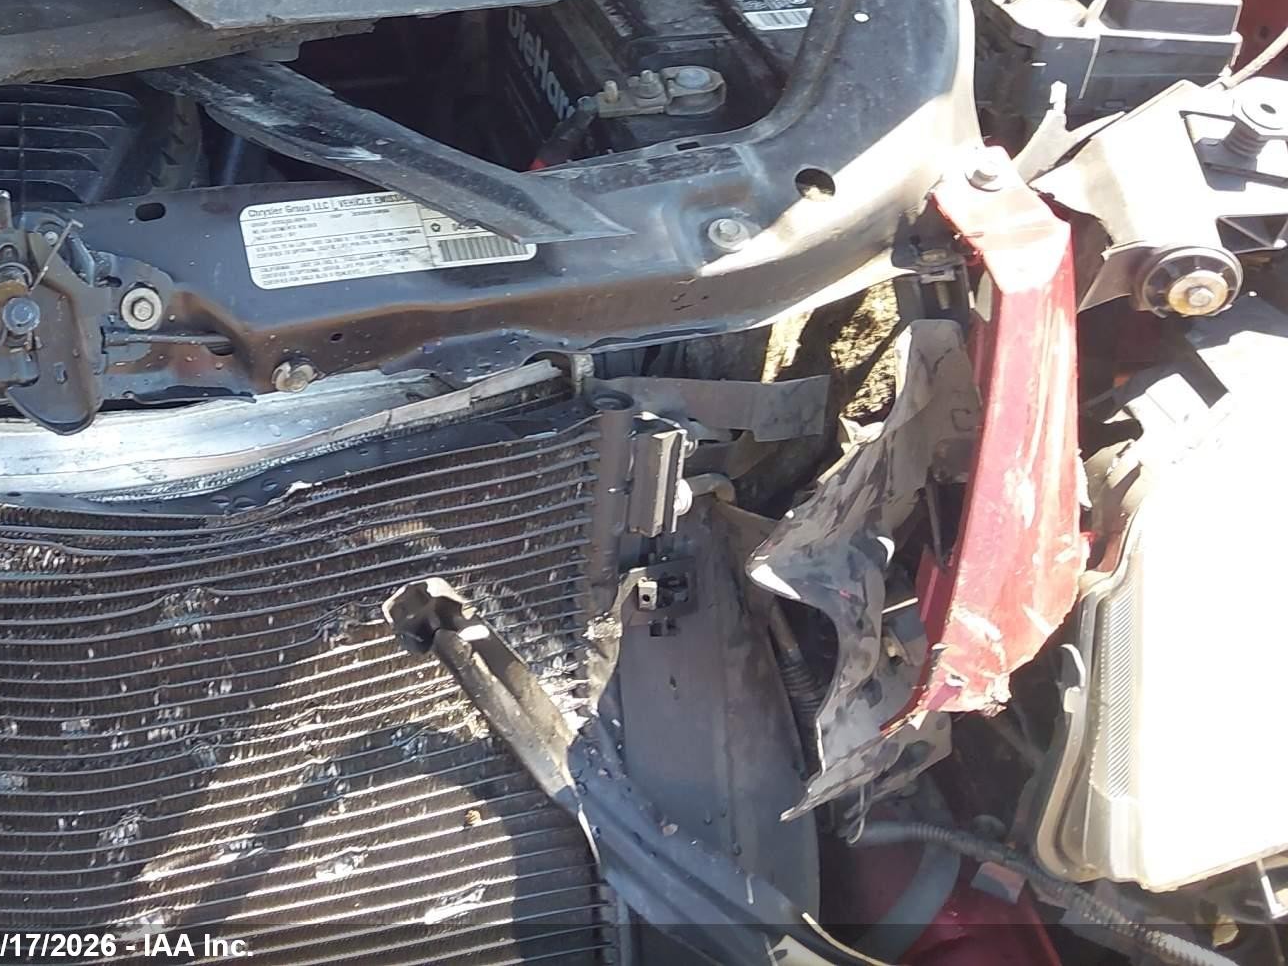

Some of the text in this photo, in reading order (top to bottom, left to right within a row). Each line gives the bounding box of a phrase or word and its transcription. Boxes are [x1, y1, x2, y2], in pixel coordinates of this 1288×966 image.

[248, 204, 283, 219] Chrysler
[286, 203, 310, 216] Group
[313, 200, 330, 211] LLC
